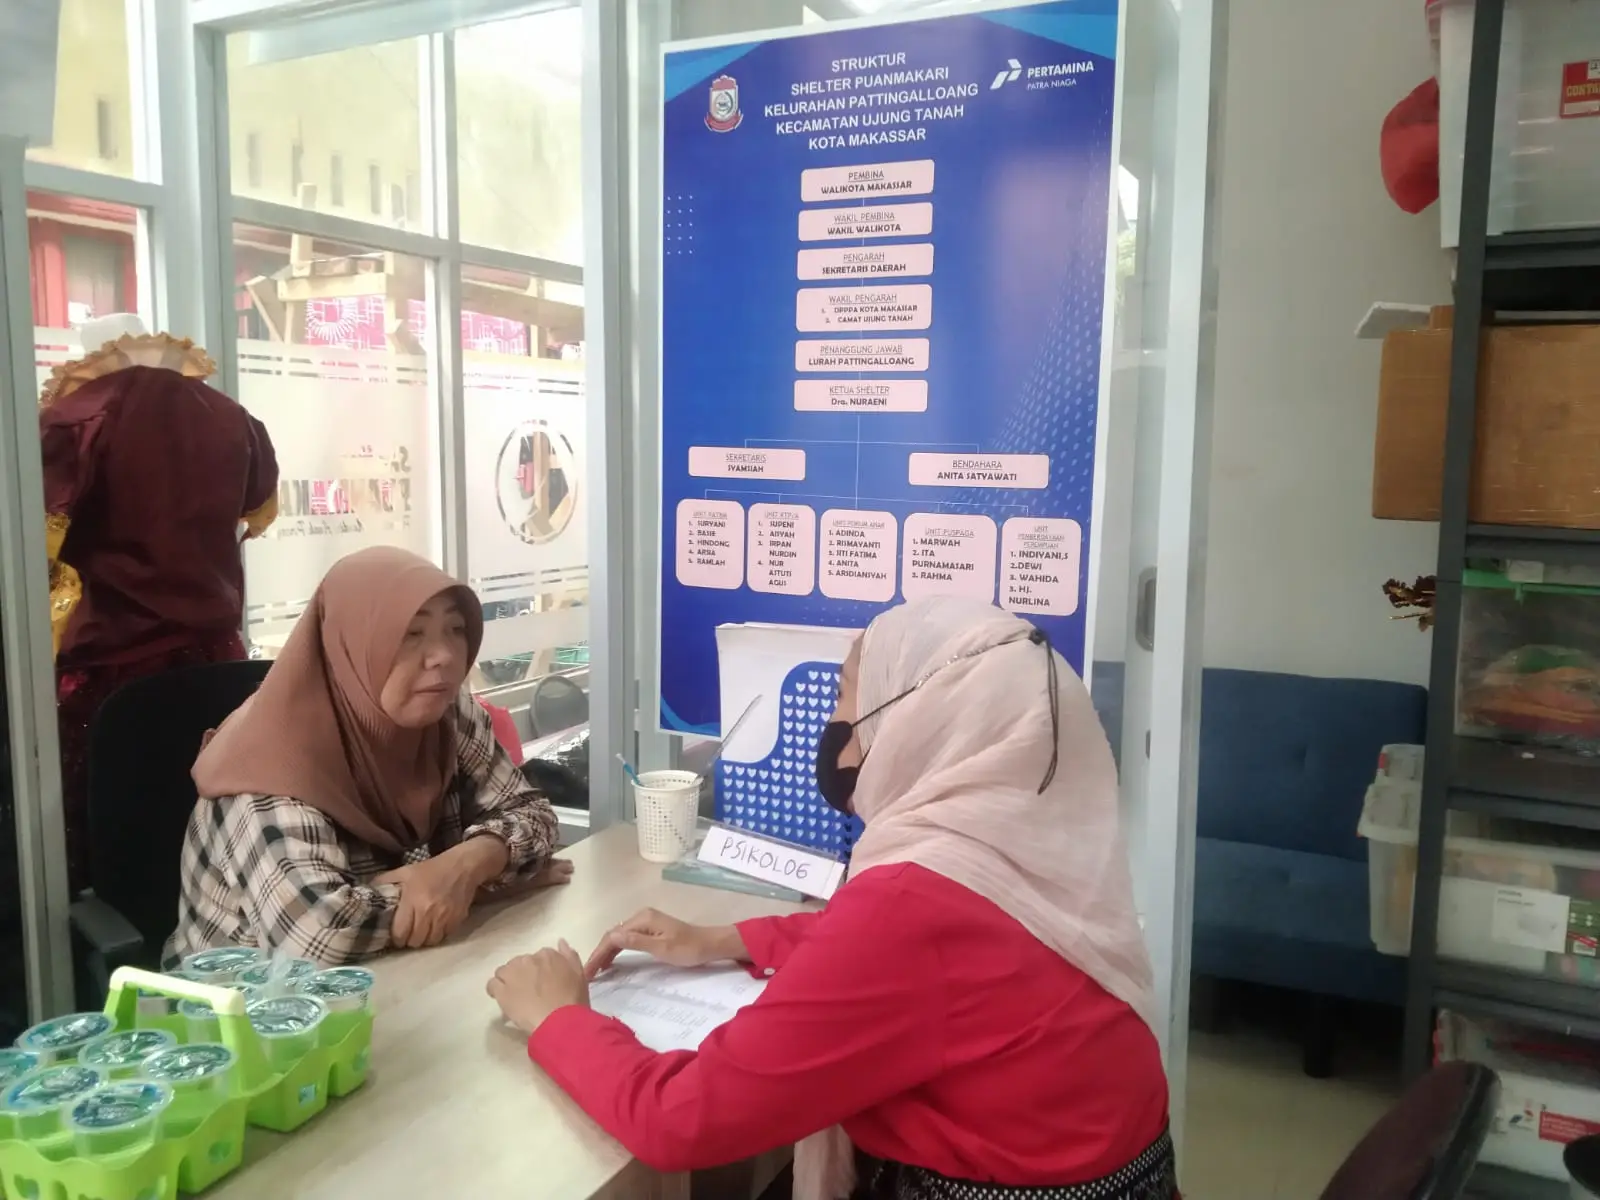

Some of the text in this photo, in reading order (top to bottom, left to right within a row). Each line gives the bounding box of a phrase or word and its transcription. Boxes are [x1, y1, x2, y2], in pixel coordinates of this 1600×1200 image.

[832, 52, 906, 73] STRUKTUR
[1028, 60, 1094, 78] PERTAMINA
[791, 66, 949, 96] SHELTER PUANMAKARI
[1028, 78, 1077, 90] PATRA NIAGA
[765, 83, 978, 117] KELURAHAN PATTINGALLOANG
[776, 104, 964, 135] KECAMATAN UJUNG TANAH
[809, 128, 926, 150] KOTA MAKASSAR
[848, 170, 885, 181] PEMBINA
[821, 181, 912, 194] WALIKOTA MAKASSAR
[834, 212, 895, 224] WAKIL PEMBINA
[828, 224, 902, 236] WAKIL WALIKOTA
[844, 252, 885, 262] PENGARAH
[822, 264, 906, 275] SEKRETARIS DAERAH
[828, 293, 897, 304] WAKIL PENGARAH
[808, 357, 915, 366] LURAH PATTINGALLOANG
[829, 386, 890, 395] KETUA SHELTER
[850, 398, 887, 406] NURAENI
[952, 460, 1002, 470] BENDAHARA
[938, 472, 1017, 480] ANITA SATYAWATI
[697, 520, 726, 528] SURYANI
[836, 530, 866, 538] ADINDA
[697, 540, 730, 548] HINDONG
[920, 538, 960, 547] MARWAH
[769, 550, 797, 558] NURDIN
[849, 550, 877, 558] FATIMA
[696, 558, 726, 567] RAMLAH
[836, 560, 859, 568] ANITA
[912, 560, 974, 571] PURNAMASARI
[920, 572, 952, 581] RAHMA
[1018, 574, 1059, 583] WAHIDA
[1008, 596, 1050, 607] NURLINA
[720, 836, 811, 880] PSIKOLOG
